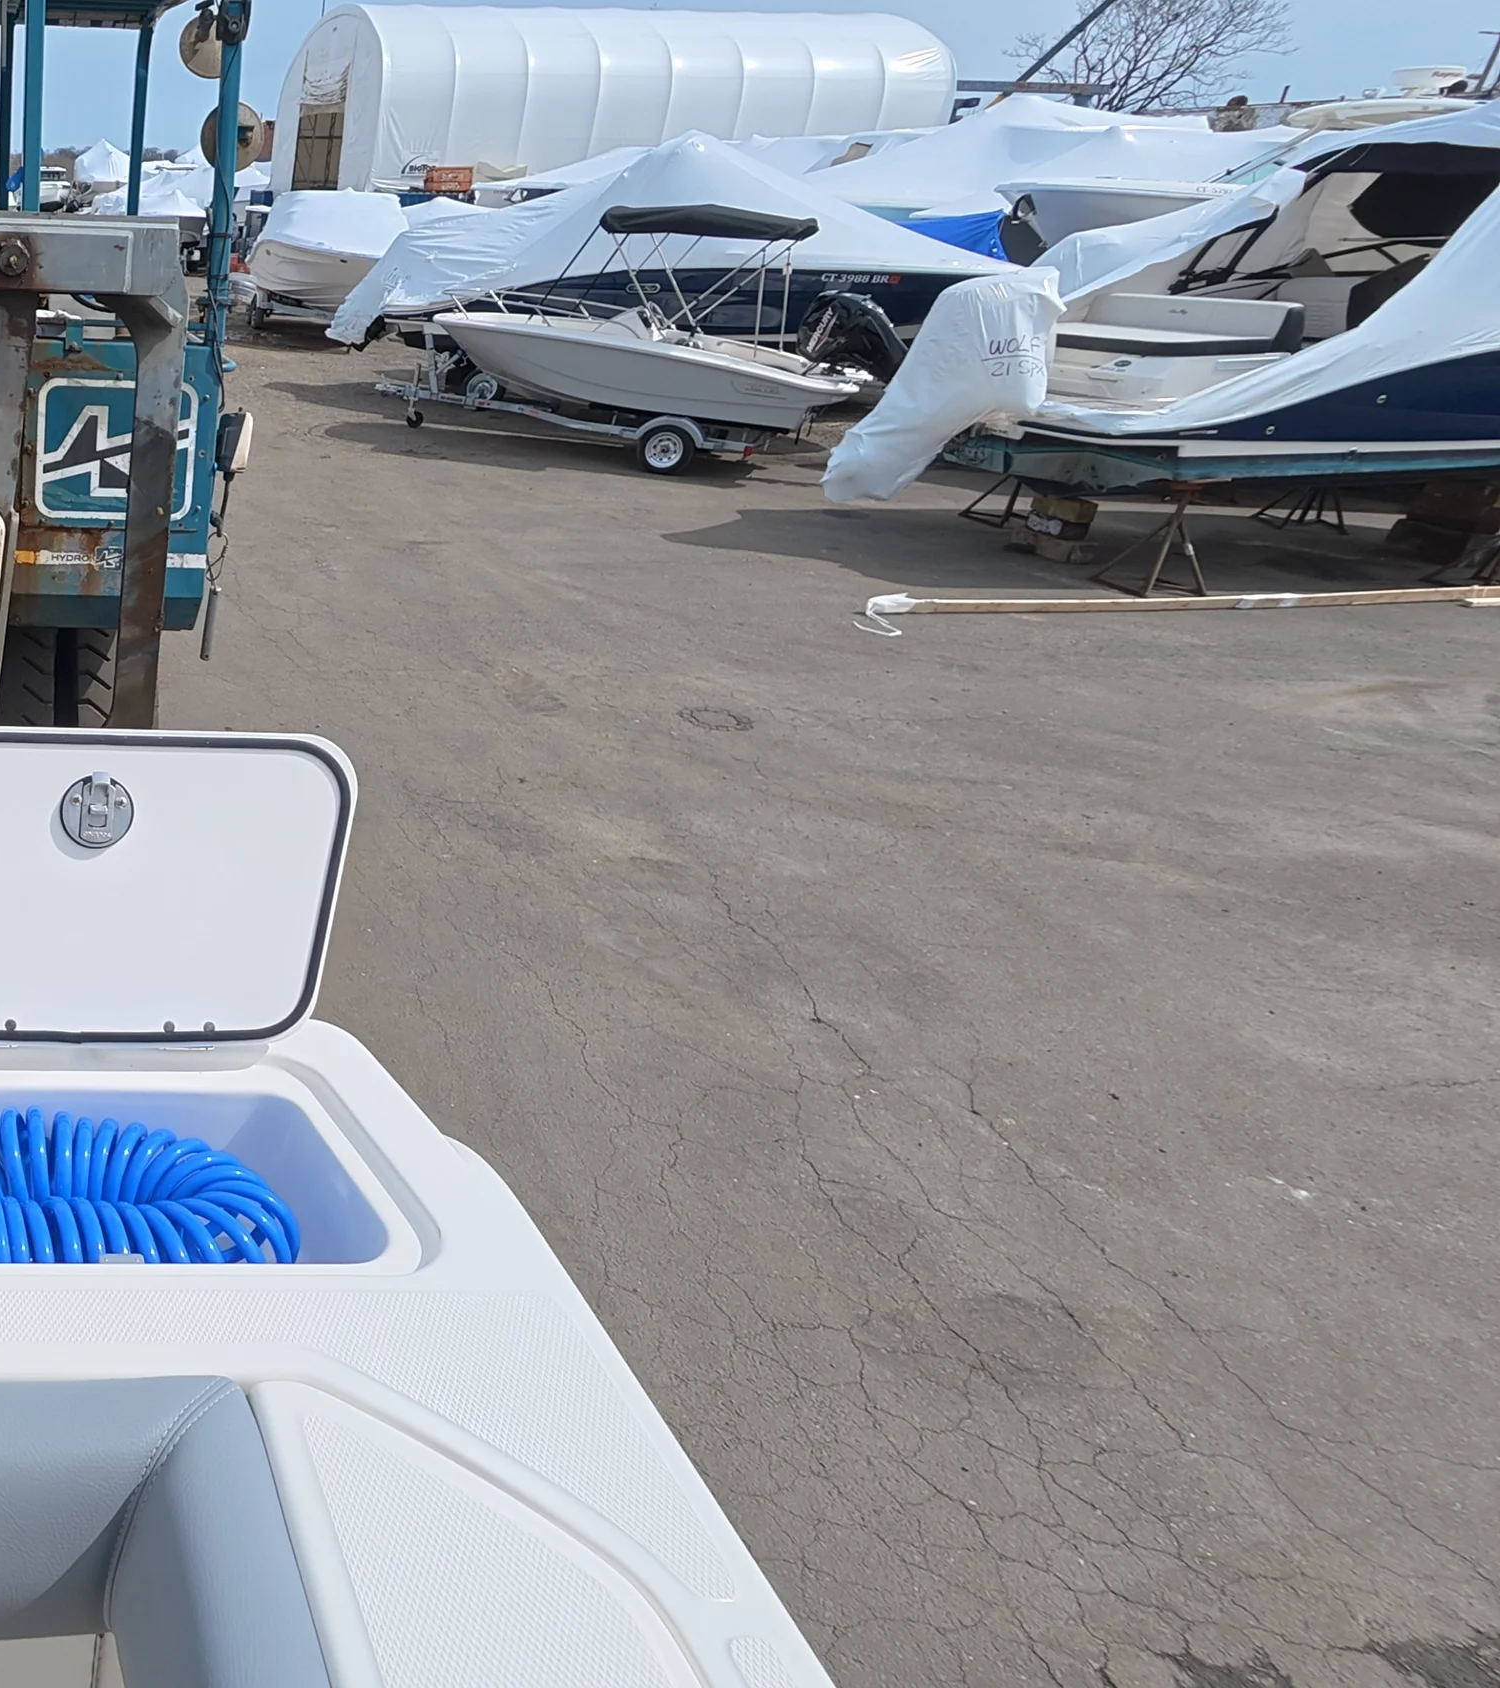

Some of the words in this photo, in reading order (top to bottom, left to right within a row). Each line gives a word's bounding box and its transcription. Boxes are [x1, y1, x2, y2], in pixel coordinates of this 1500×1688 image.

[820, 272, 838, 283] CT
[838, 273, 870, 284] 3988
[870, 274, 890, 284] BR
[806, 306, 834, 353] MERCURY
[989, 334, 1041, 355] WOLF
[991, 361, 1011, 377] 21
